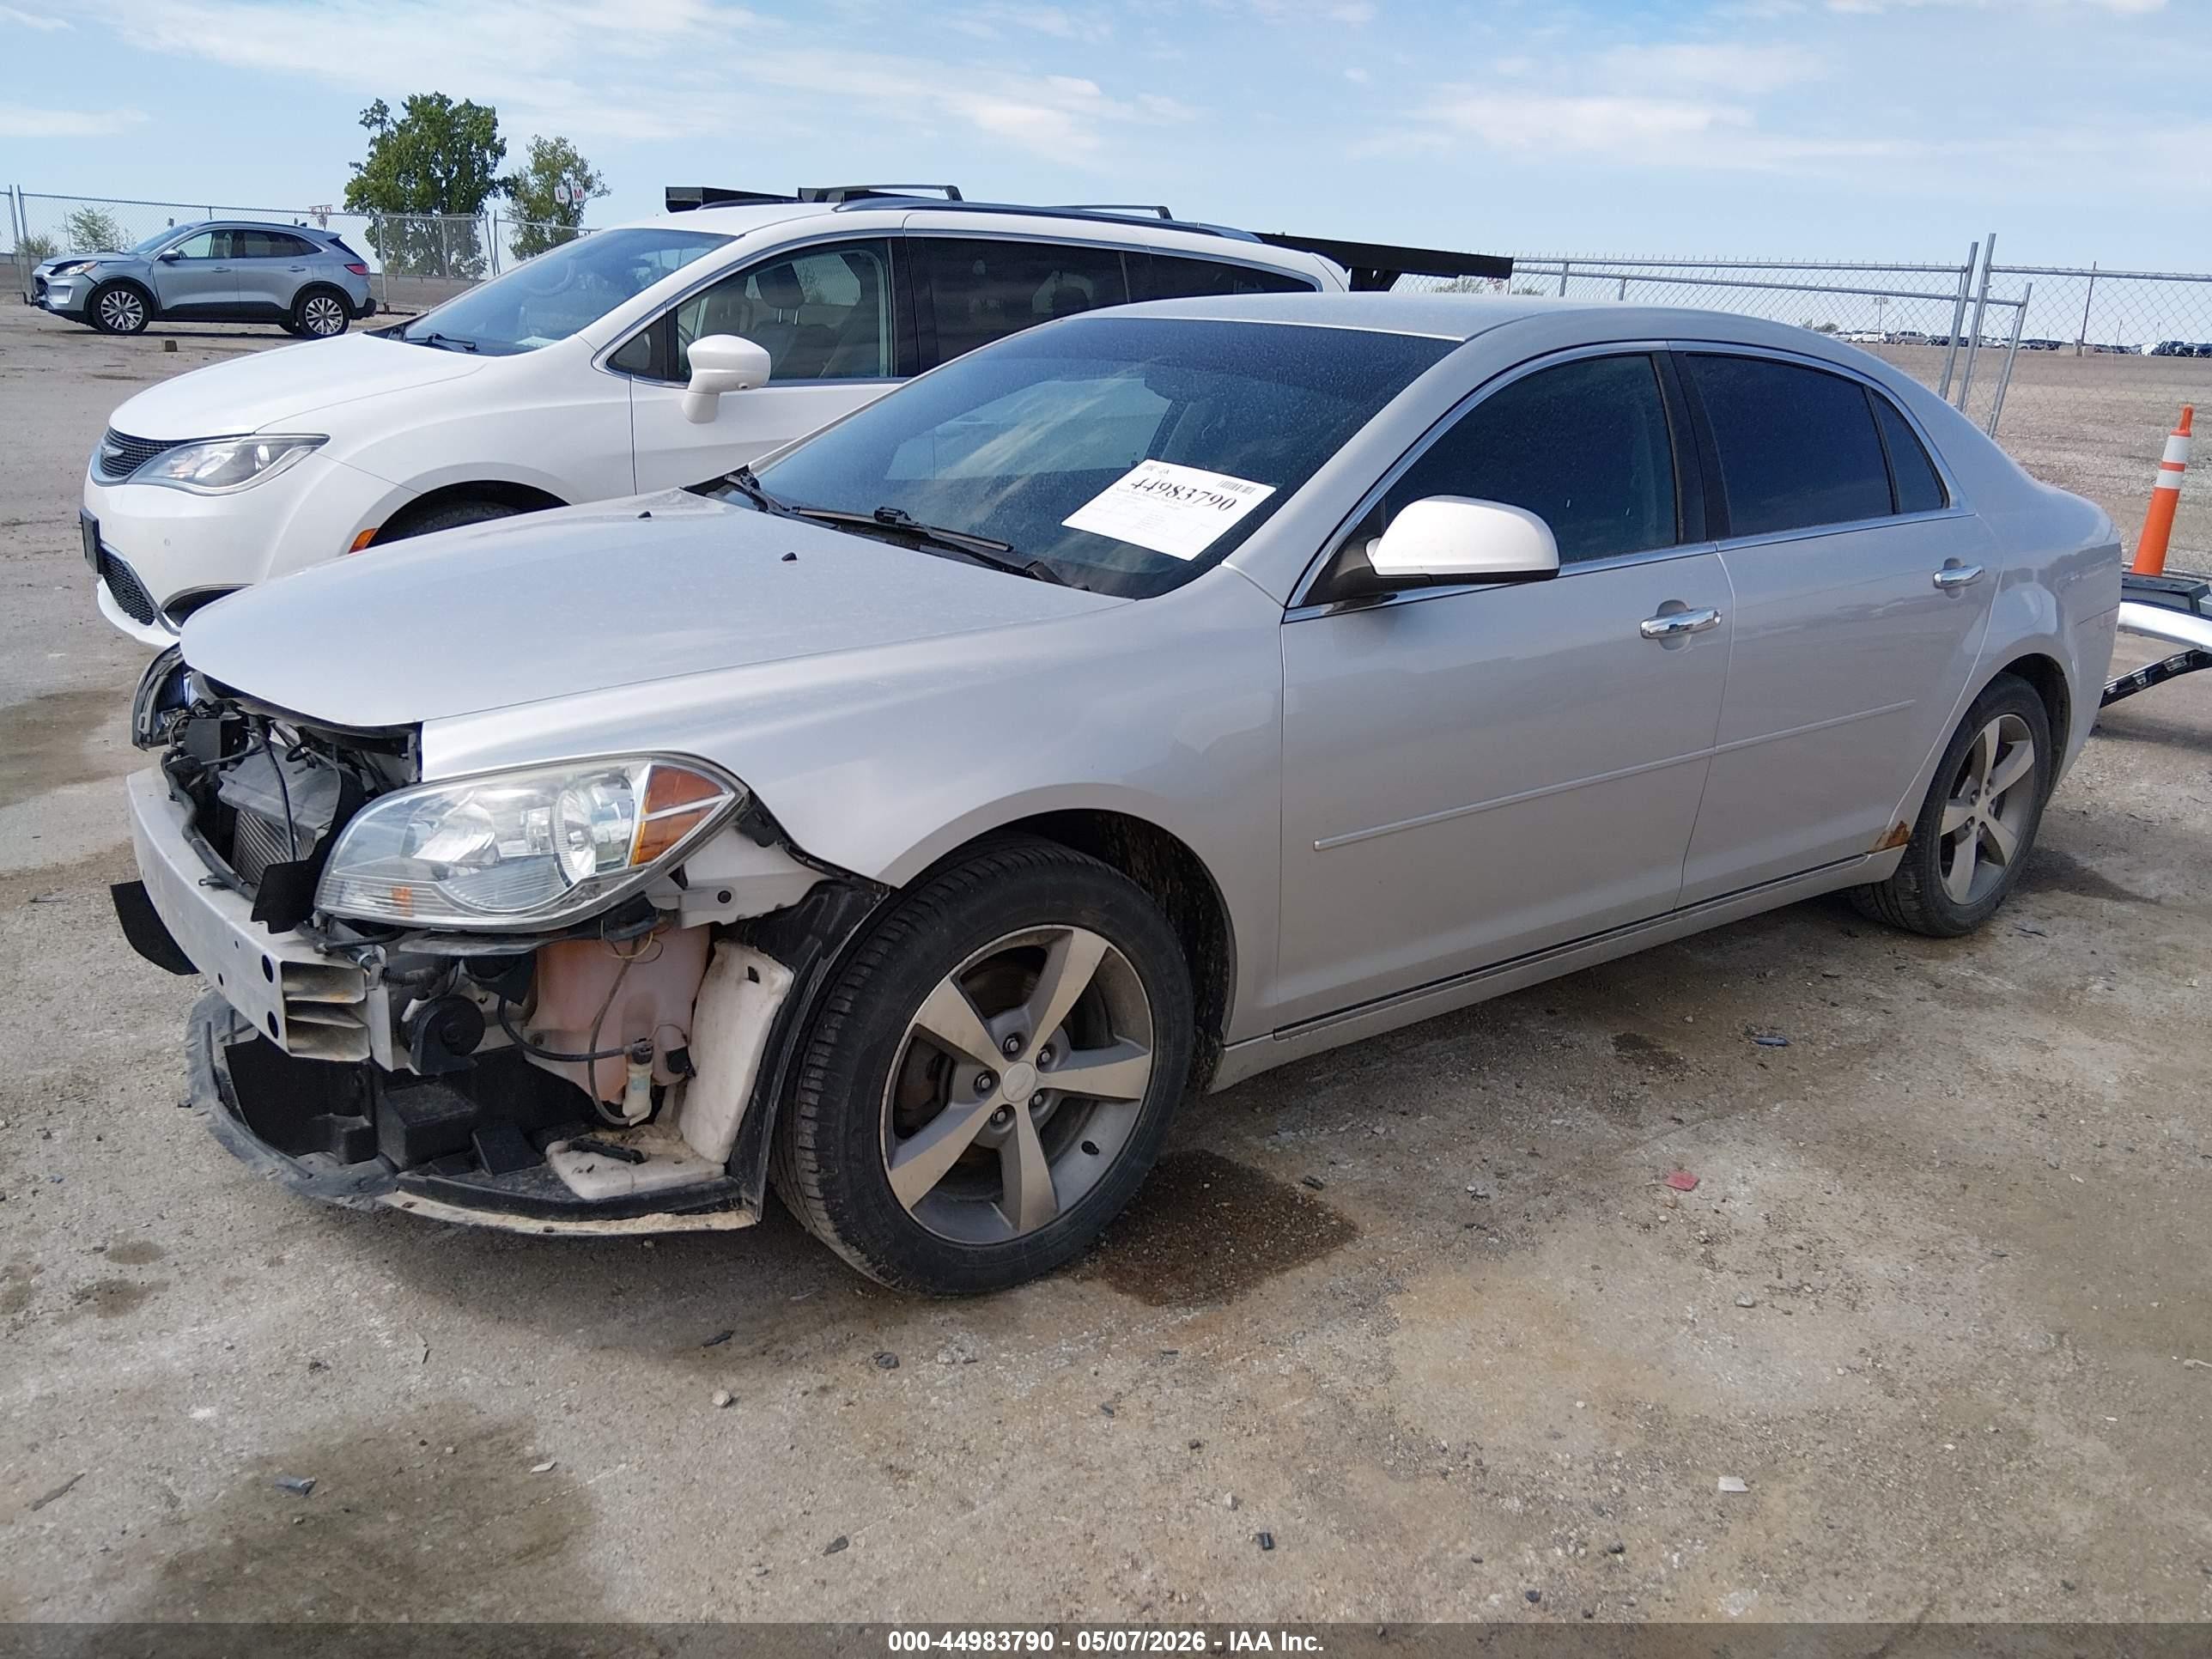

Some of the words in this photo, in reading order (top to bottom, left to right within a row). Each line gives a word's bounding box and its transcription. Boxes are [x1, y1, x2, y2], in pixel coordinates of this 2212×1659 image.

[557, 189, 565, 200] L
[574, 188, 583, 199] M
[1130, 477, 1237, 512] 44983790
